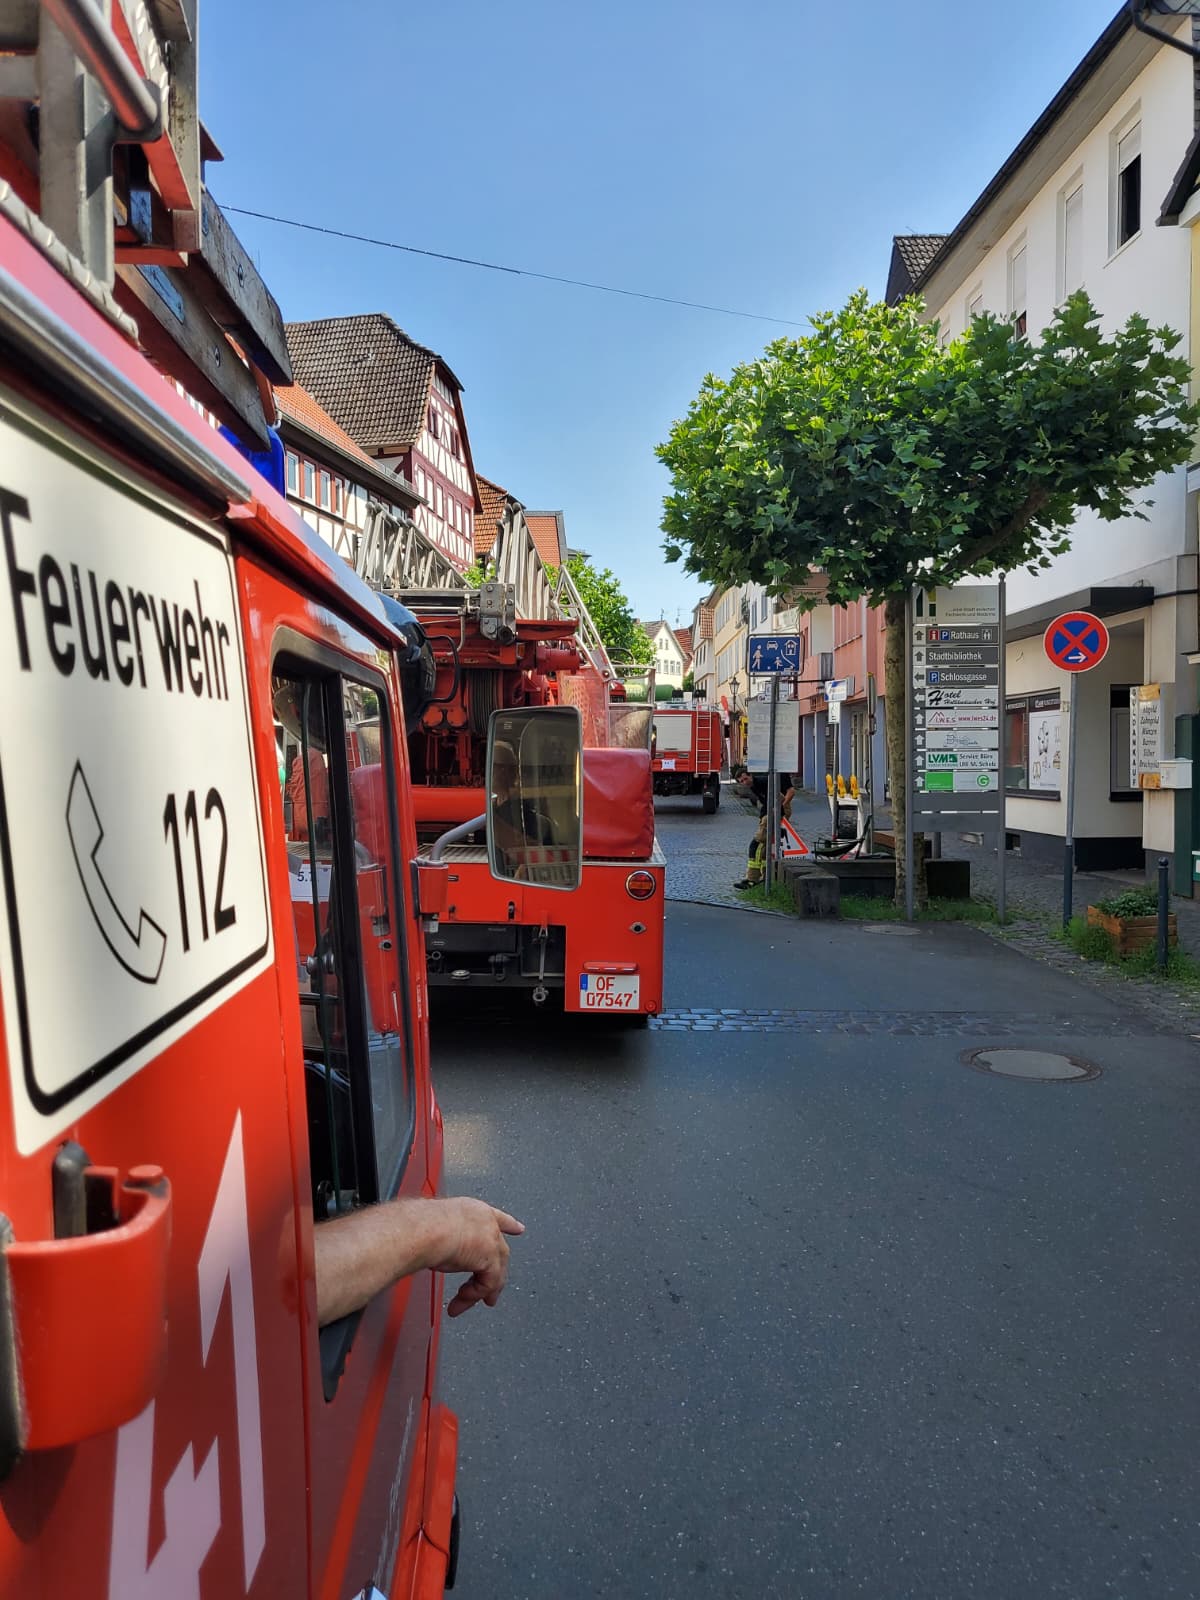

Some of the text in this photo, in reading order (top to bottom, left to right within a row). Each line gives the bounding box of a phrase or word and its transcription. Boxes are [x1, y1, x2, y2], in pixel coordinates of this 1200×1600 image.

[0, 485, 231, 701] Feuerwehr
[950, 631, 979, 640] Rathaus
[928, 651, 982, 661] Stadtbibliothek
[940, 672, 987, 683] Schlossgasse
[928, 690, 961, 706] Hotel
[928, 753, 948, 764] LVM
[163, 786, 237, 952] 112
[595, 976, 616, 991] OF
[586, 992, 633, 1007] 07547
